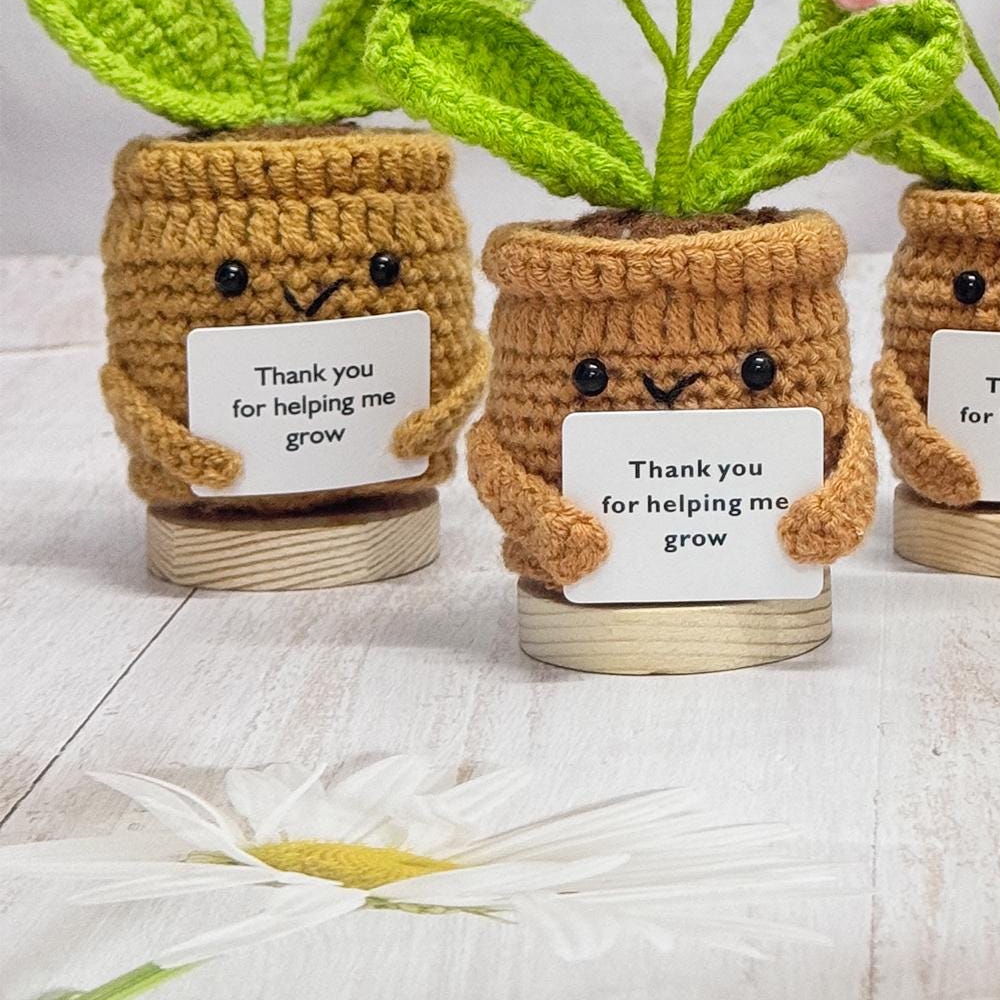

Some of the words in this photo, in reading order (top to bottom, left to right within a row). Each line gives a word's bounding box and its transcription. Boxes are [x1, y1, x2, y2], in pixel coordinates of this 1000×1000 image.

[254, 363, 327, 386] Thank
[333, 363, 374, 387] you
[232, 399, 267, 419] for
[274, 394, 355, 420] helping
[361, 392, 396, 409] me
[959, 406, 994, 424] for
[286, 428, 346, 452] grow
[628, 460, 711, 479] Thank
[717, 463, 763, 483] you
[601, 495, 640, 514] for
[647, 494, 743, 518] helping
[749, 496, 789, 511] me
[663, 533, 728, 553] grow
